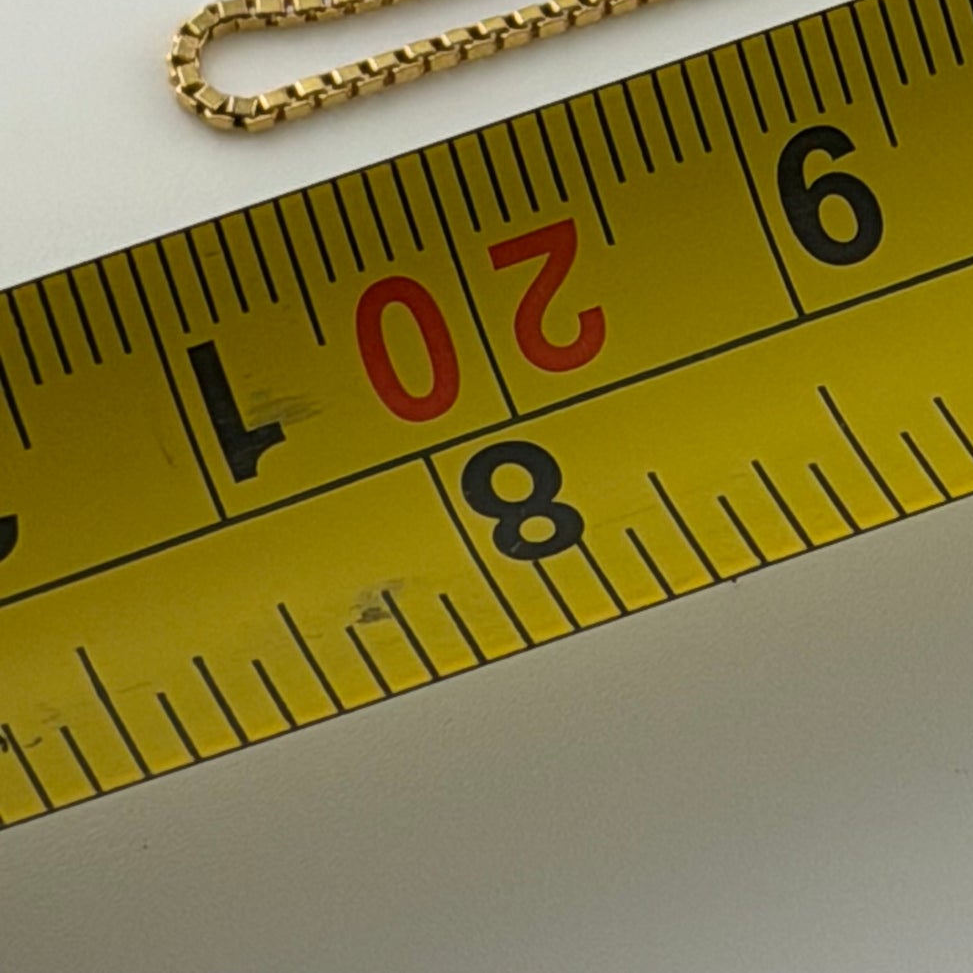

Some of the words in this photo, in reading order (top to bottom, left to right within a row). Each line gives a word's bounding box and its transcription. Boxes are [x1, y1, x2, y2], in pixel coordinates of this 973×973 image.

[775, 124, 885, 267] 9
[355, 217, 607, 424] 20
[186, 339, 287, 484] 1
[460, 440, 586, 561] 8
